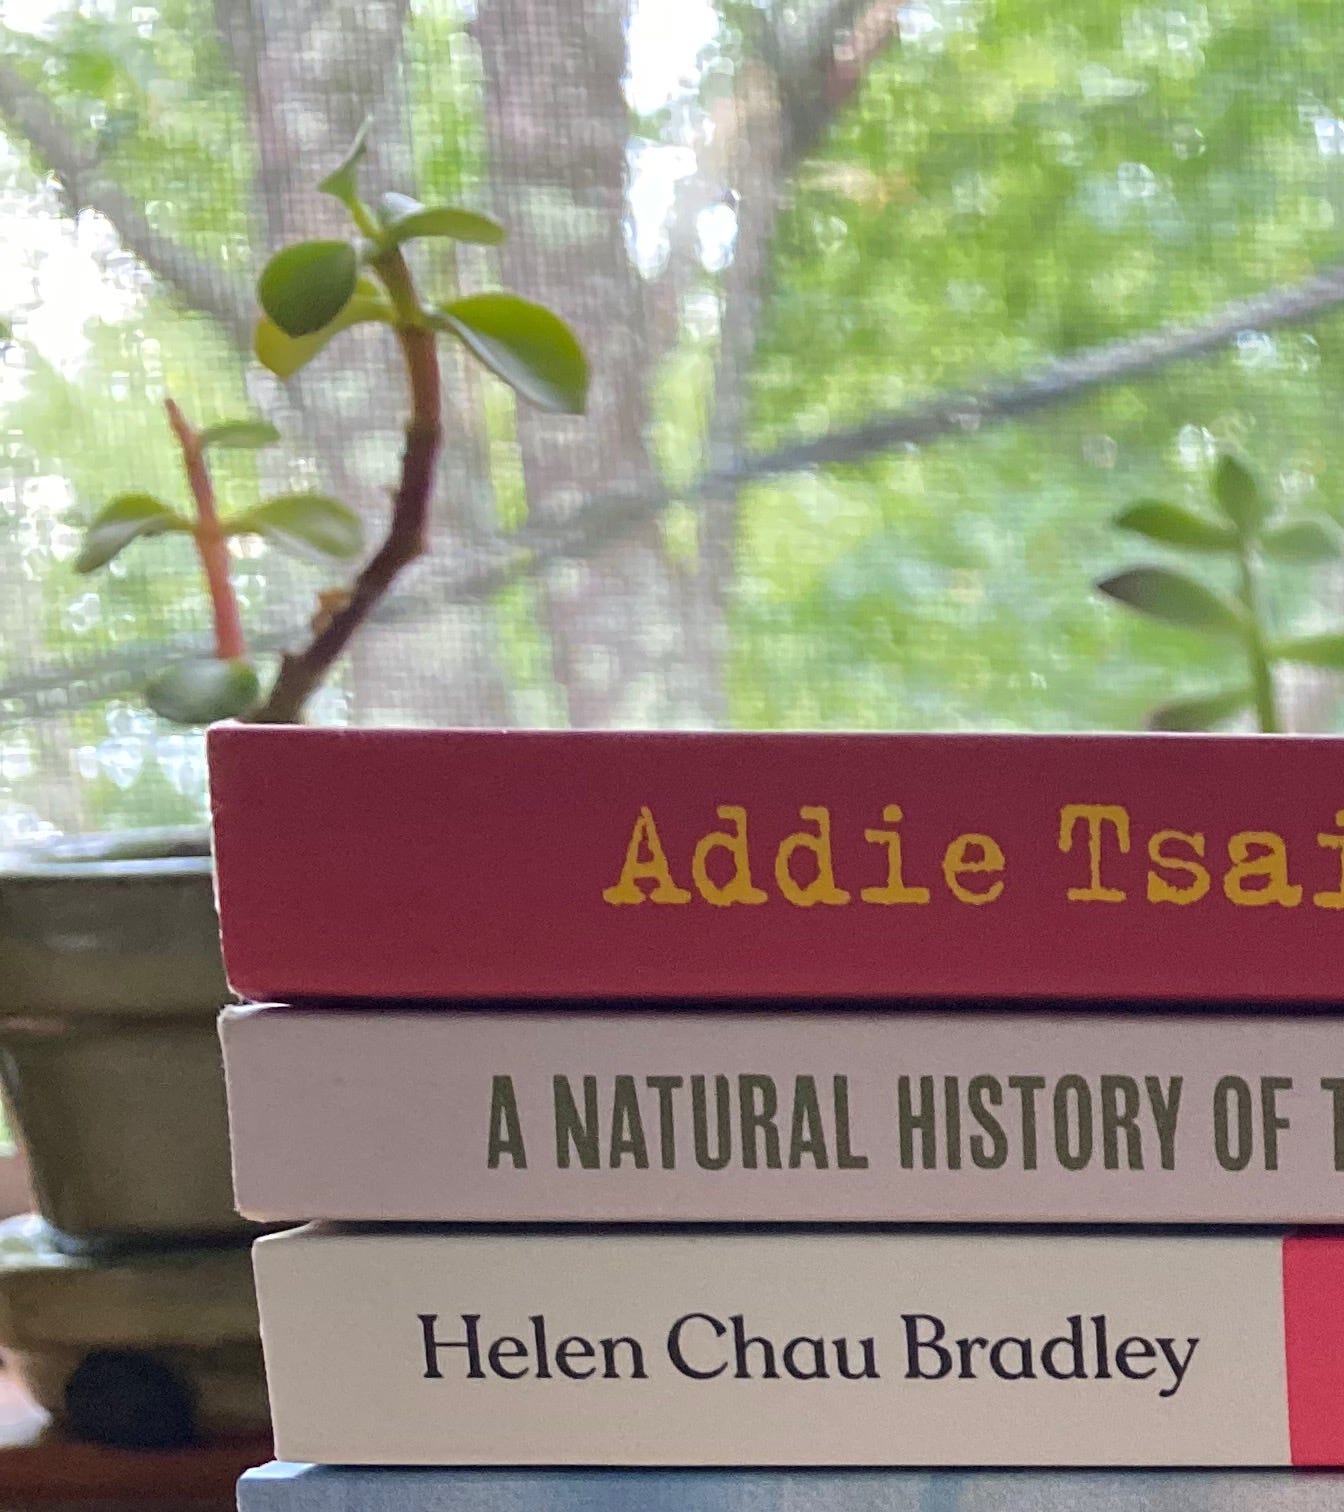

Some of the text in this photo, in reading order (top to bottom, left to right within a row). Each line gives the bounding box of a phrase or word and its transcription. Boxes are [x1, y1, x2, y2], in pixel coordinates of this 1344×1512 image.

[602, 803, 1005, 907] Addie
[487, 1074, 528, 1170] A
[553, 1074, 869, 1171] NATURAL
[897, 1075, 1184, 1172] HISTORY
[1212, 1076, 1293, 1173] OF
[418, 1313, 1200, 1398] Helen Chau Bradley
